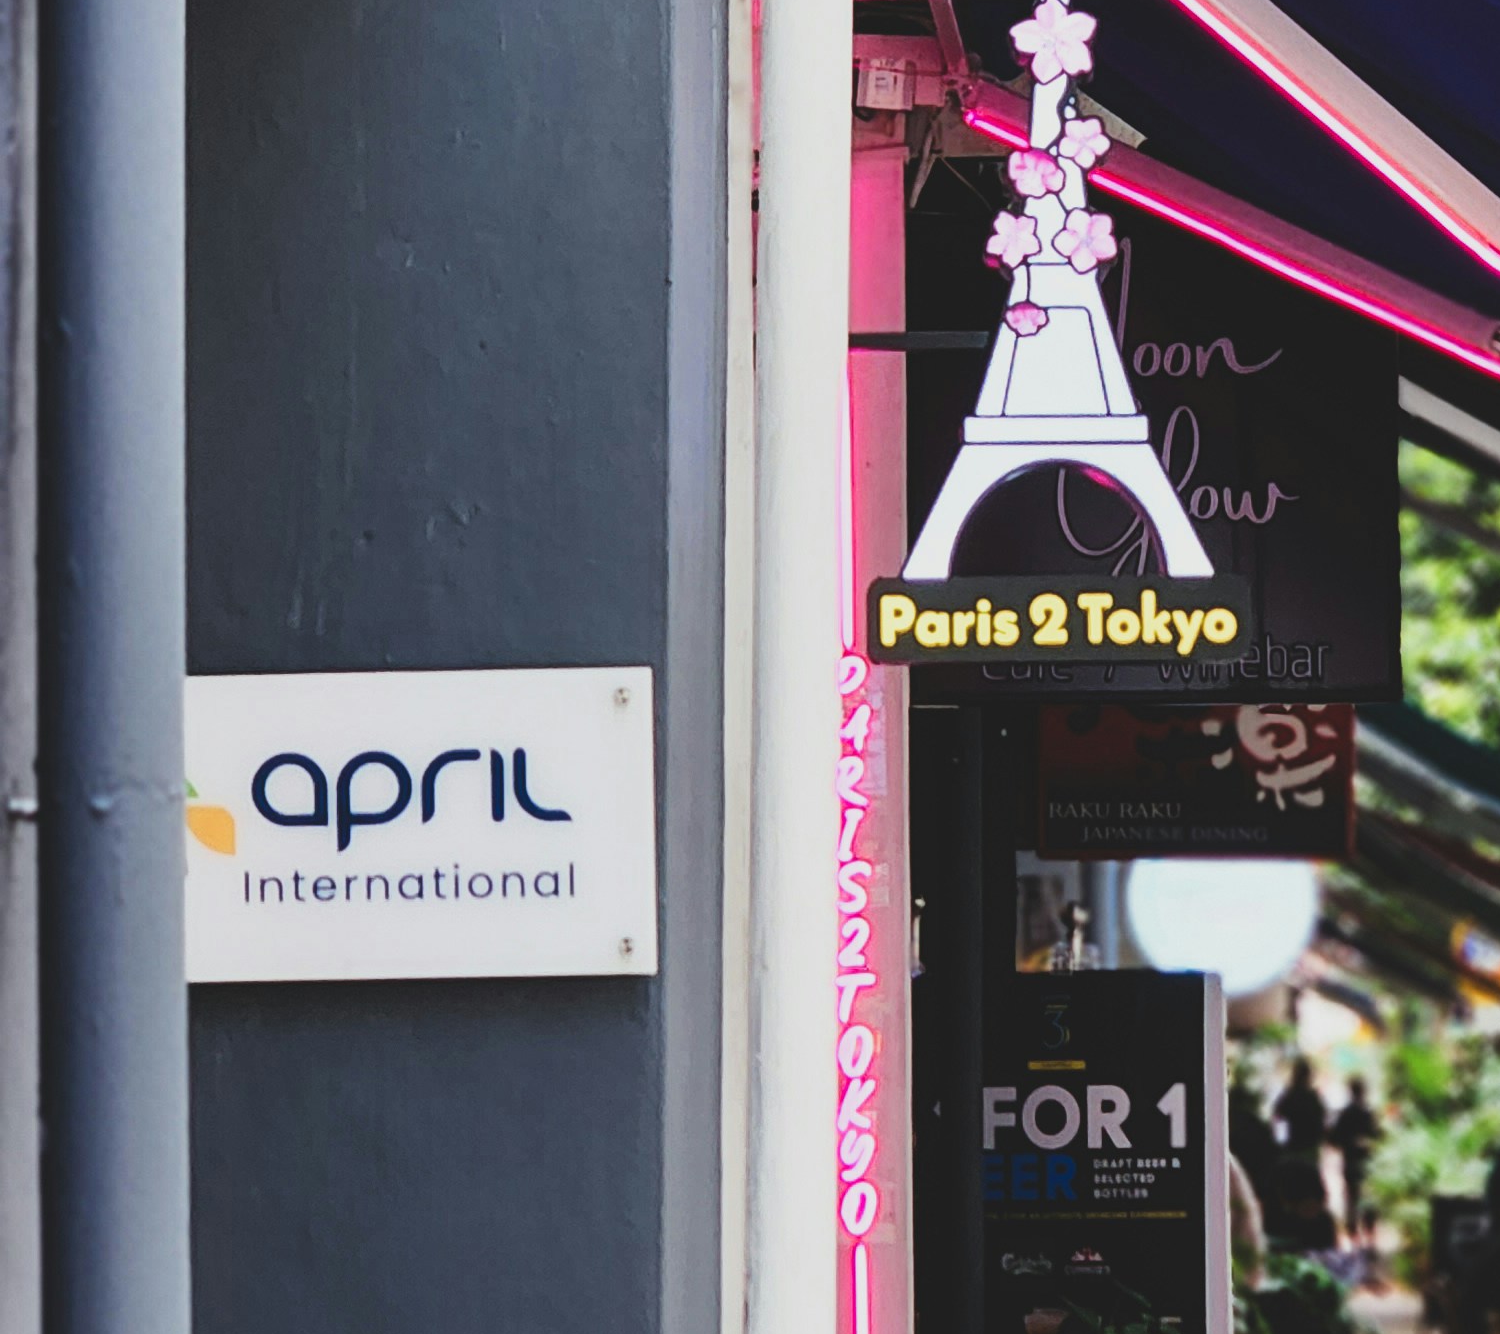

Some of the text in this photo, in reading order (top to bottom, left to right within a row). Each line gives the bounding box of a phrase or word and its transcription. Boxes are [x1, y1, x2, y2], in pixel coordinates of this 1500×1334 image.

[878, 589, 1239, 655] Paris 2 Tokyo
[251, 746, 572, 853] april
[1048, 801, 1183, 819] RAKU RAKU
[243, 863, 576, 904] International
[982, 1082, 1188, 1150] FOR 1
